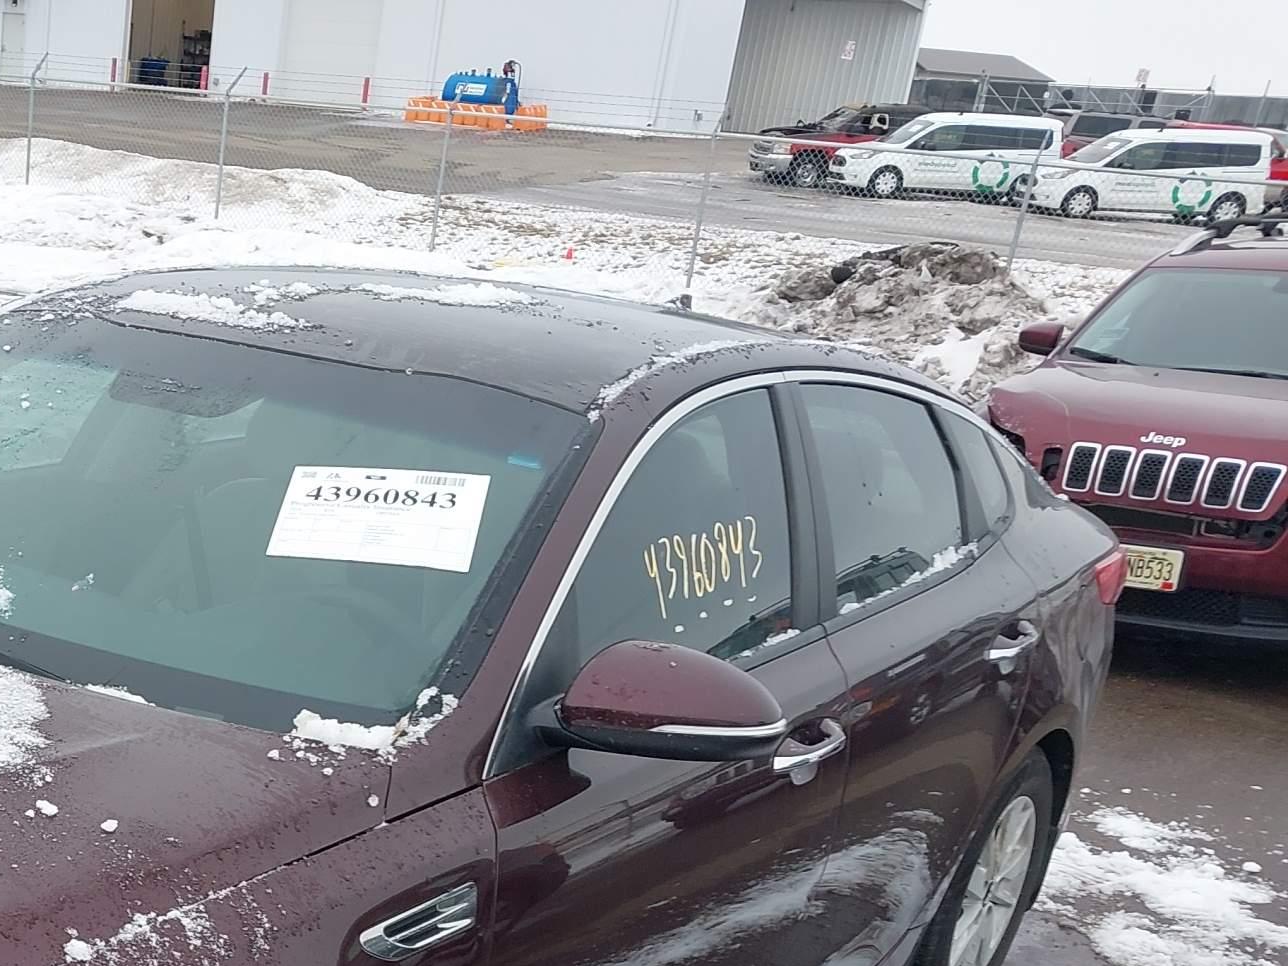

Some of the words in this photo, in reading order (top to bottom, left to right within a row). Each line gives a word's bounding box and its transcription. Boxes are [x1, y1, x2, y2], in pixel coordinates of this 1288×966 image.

[1140, 431, 1186, 448] Jeep
[306, 486, 456, 509] 43960843
[644, 516, 762, 619] 43960843
